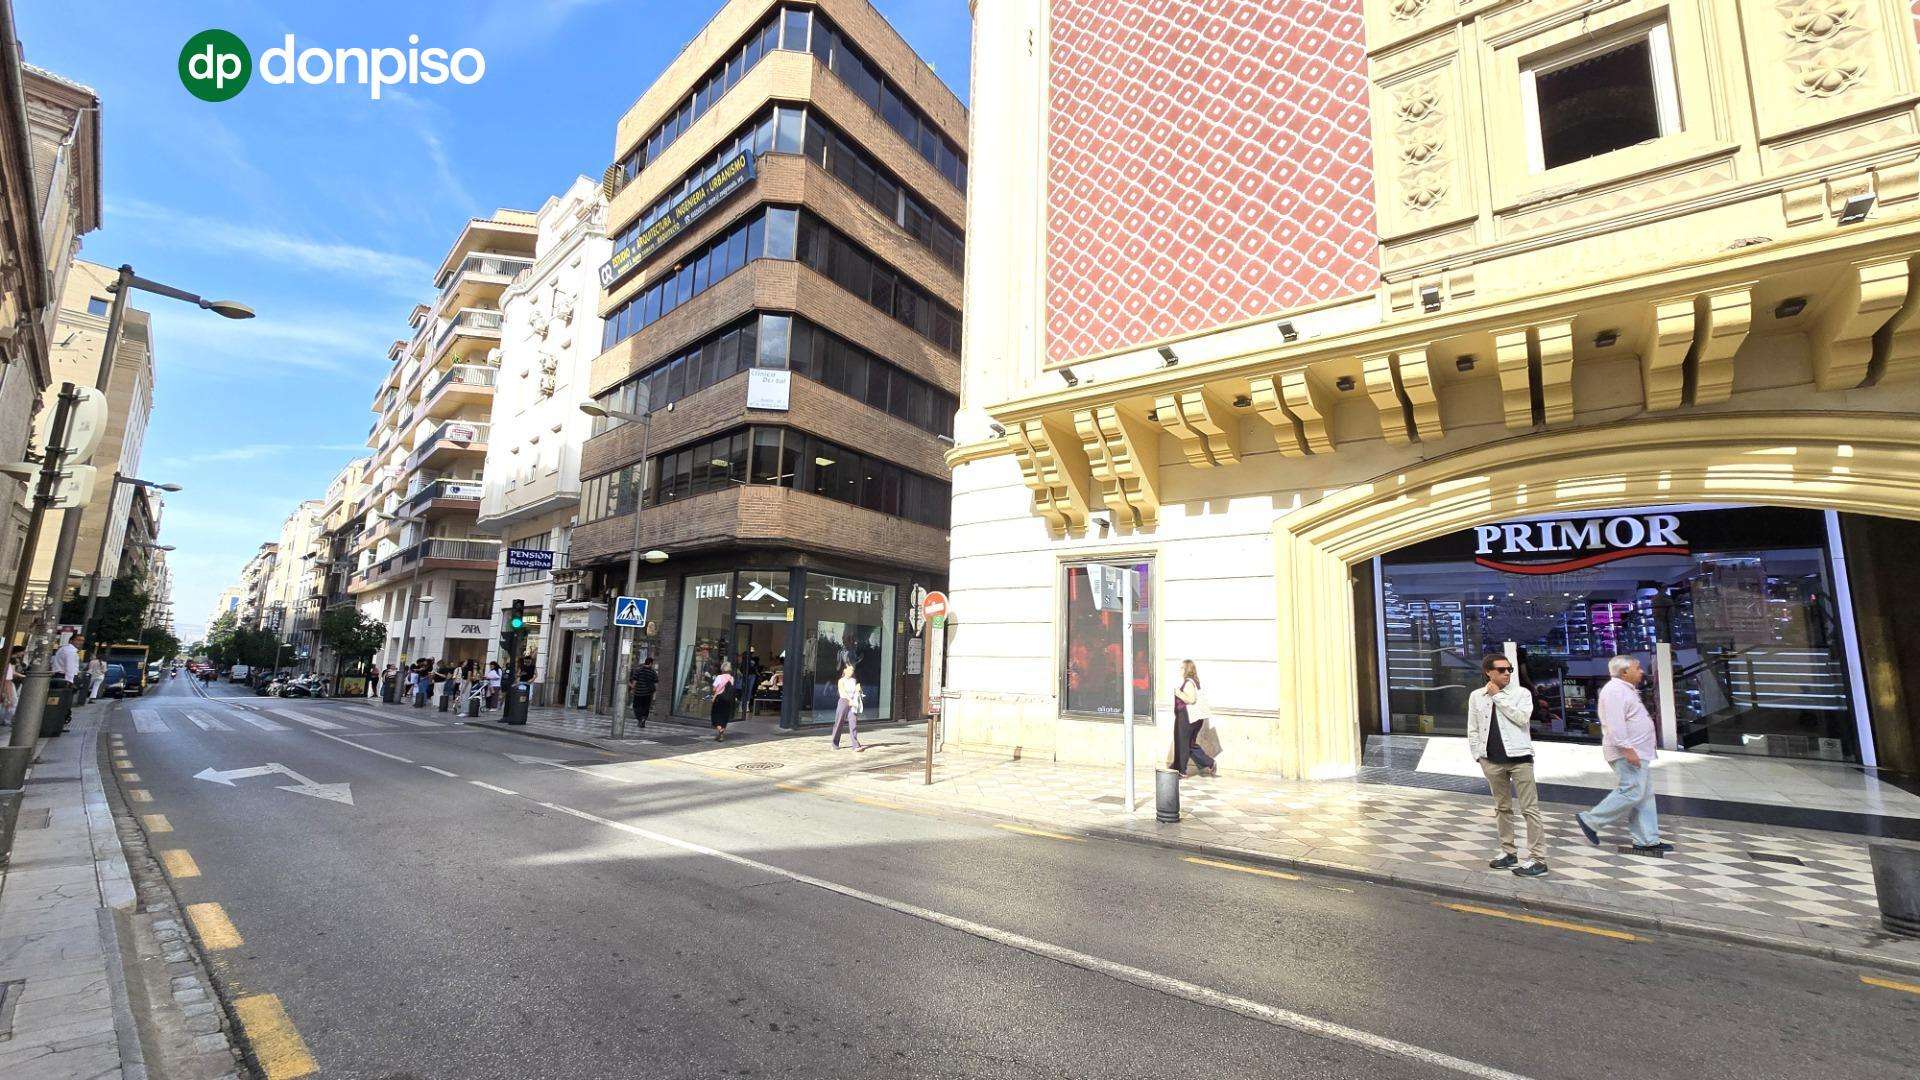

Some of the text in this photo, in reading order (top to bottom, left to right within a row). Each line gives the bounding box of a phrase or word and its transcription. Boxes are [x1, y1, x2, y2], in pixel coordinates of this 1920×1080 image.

[709, 155, 746, 192] URBANISMO
[1473, 514, 1689, 555] PRIMOR
[695, 583, 727, 599] TENTH
[831, 586, 872, 605] TENTH
[460, 624, 481, 634] ZARA
